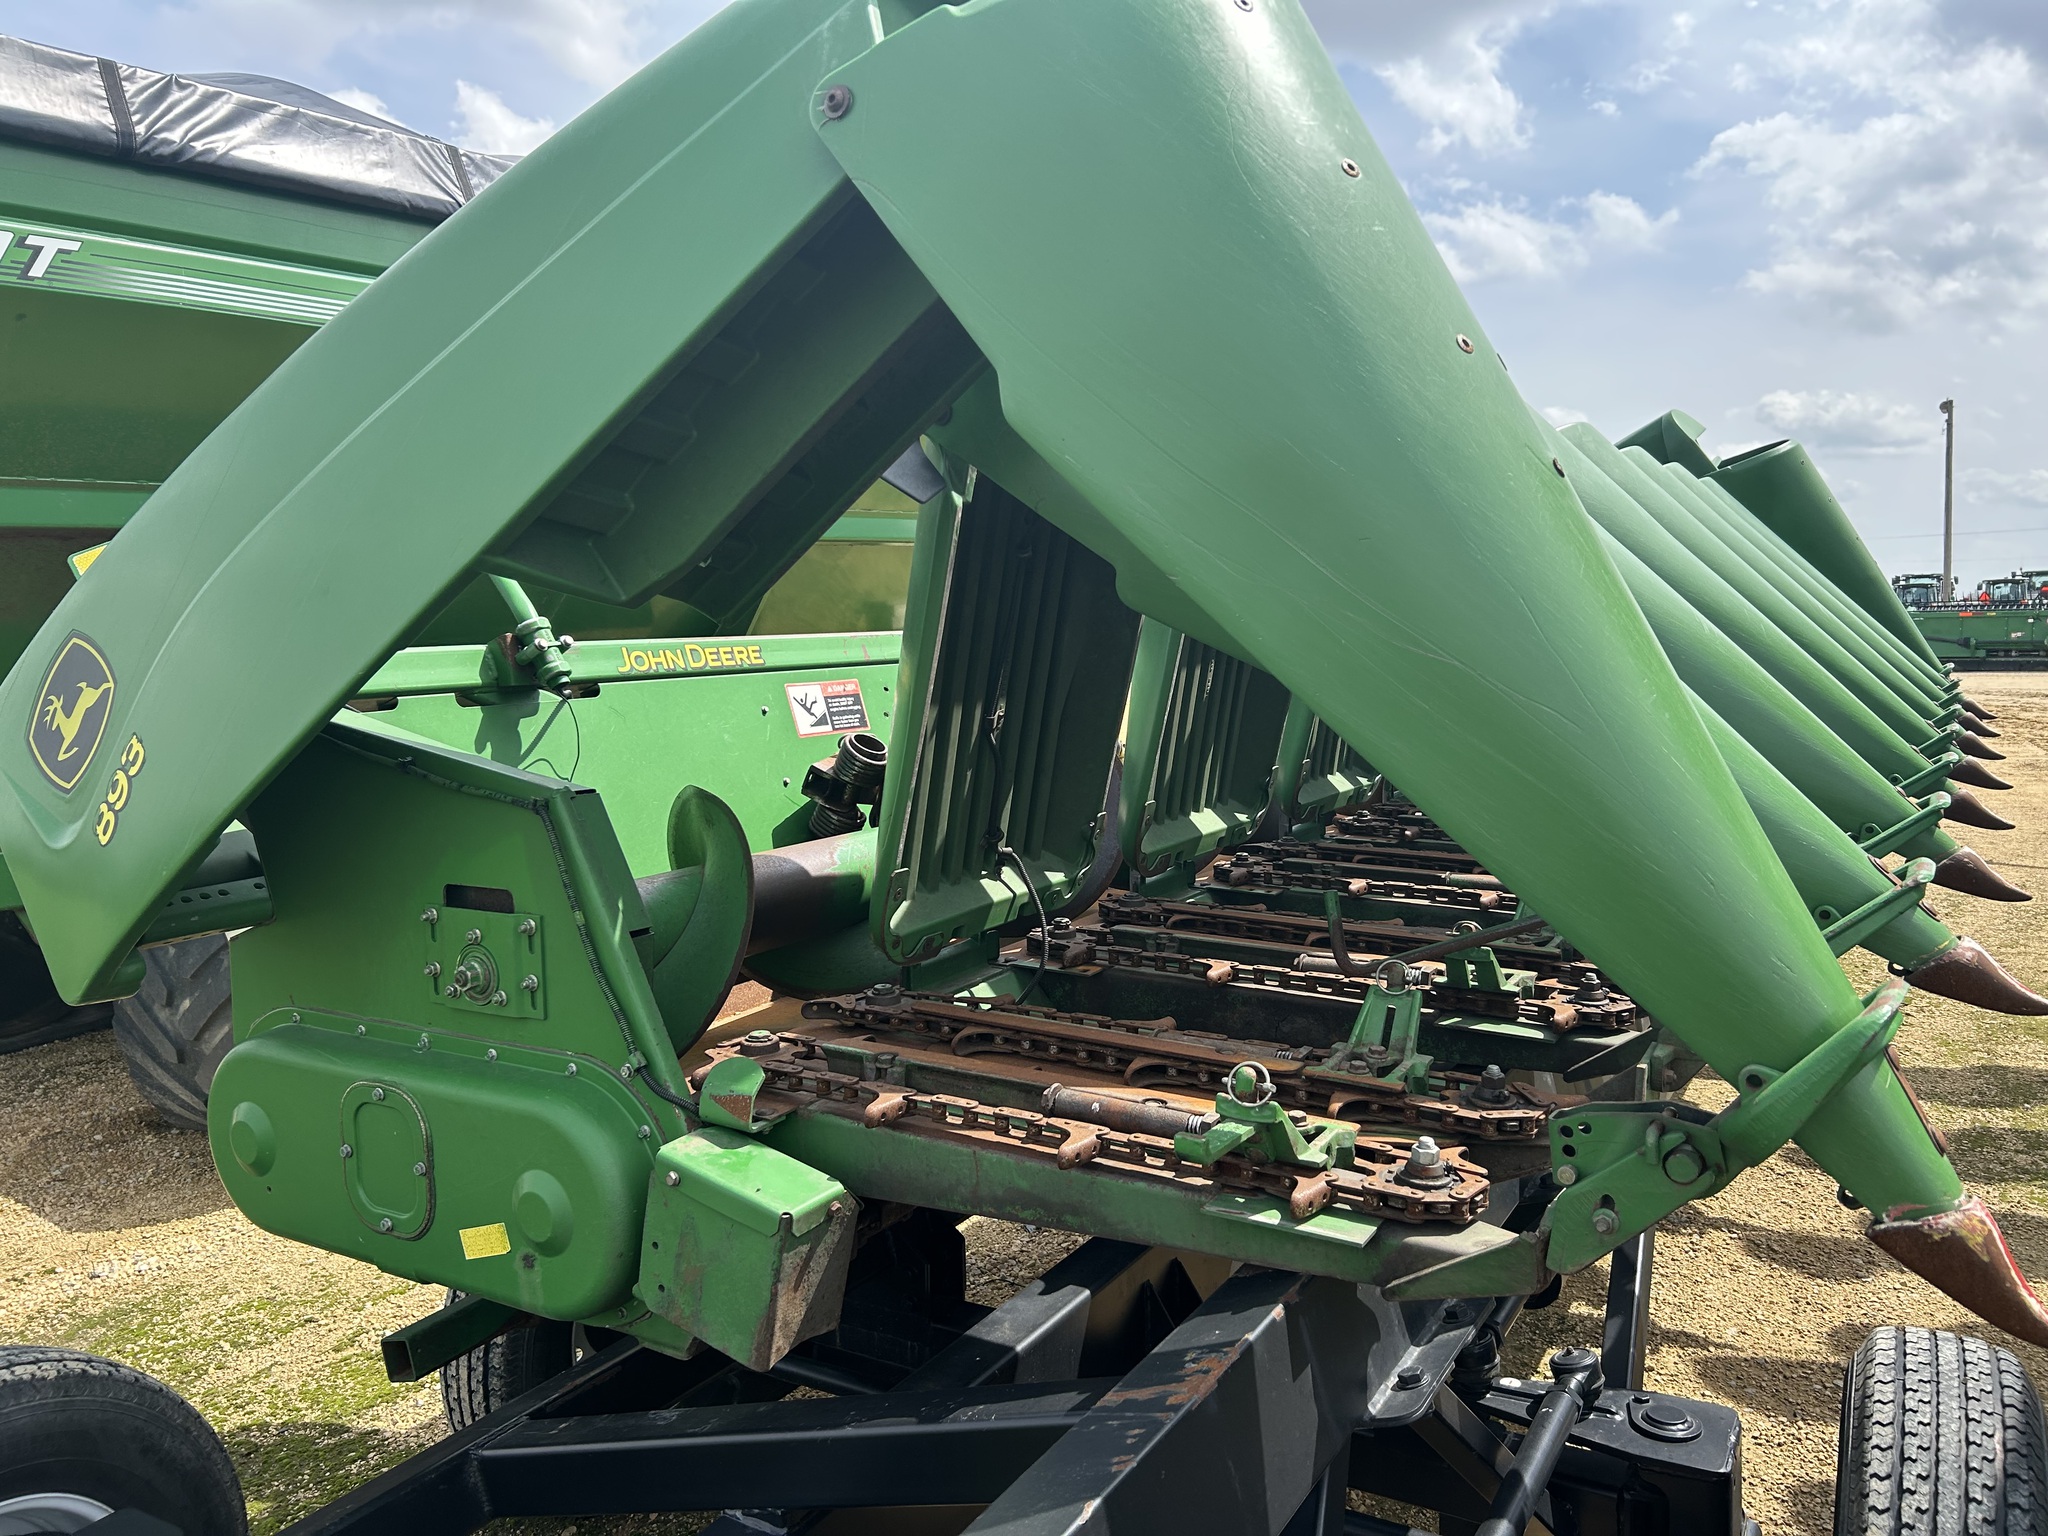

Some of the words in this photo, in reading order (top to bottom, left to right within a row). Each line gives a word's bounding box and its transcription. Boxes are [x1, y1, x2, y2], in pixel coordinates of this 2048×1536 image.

[617, 646, 688, 674] JOHN
[684, 643, 765, 670] DEERE
[94, 733, 146, 846] 893
